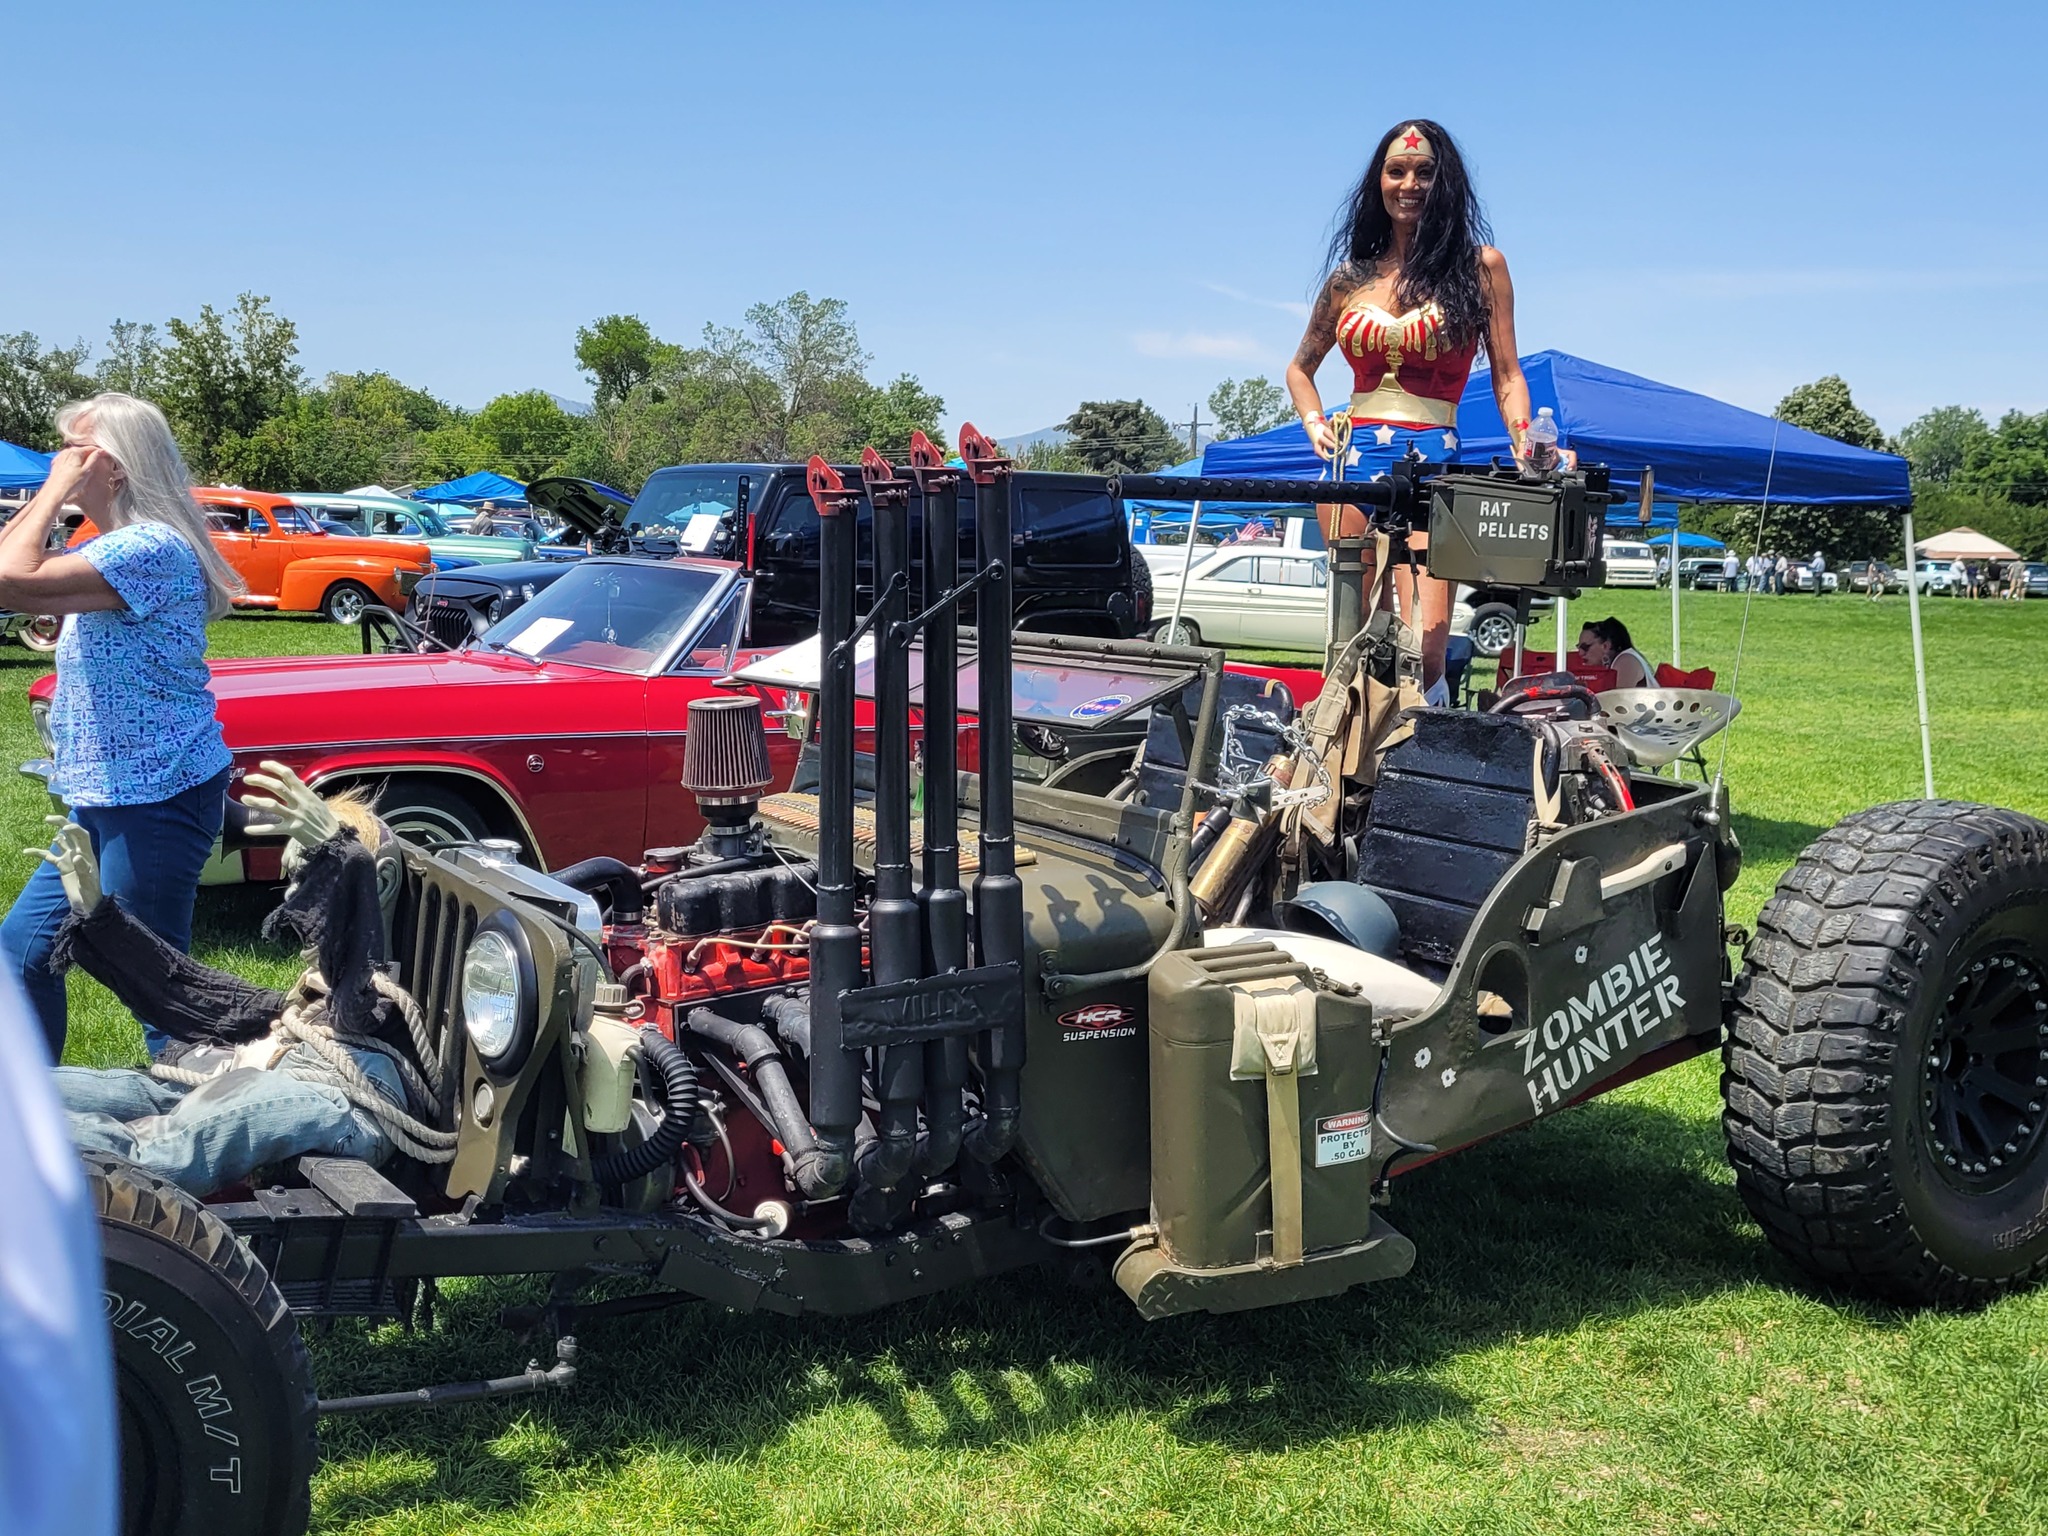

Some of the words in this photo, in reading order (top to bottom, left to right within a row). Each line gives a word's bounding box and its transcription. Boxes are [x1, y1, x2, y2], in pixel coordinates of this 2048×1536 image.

[1480, 501, 1511, 517] RAT
[1478, 521, 1549, 540] PELLETS
[1514, 931, 1671, 1076] ZOMBIE
[1074, 1009, 1122, 1024] HCR
[1062, 1027, 1136, 1042] SUSPENSION
[1527, 974, 1687, 1116] HUNTER
[1327, 1114, 1369, 1129] WARNING
[1342, 1140, 1356, 1150] BY
[1331, 1151, 1346, 1161] .50
[1348, 1147, 1366, 1158] CAL
